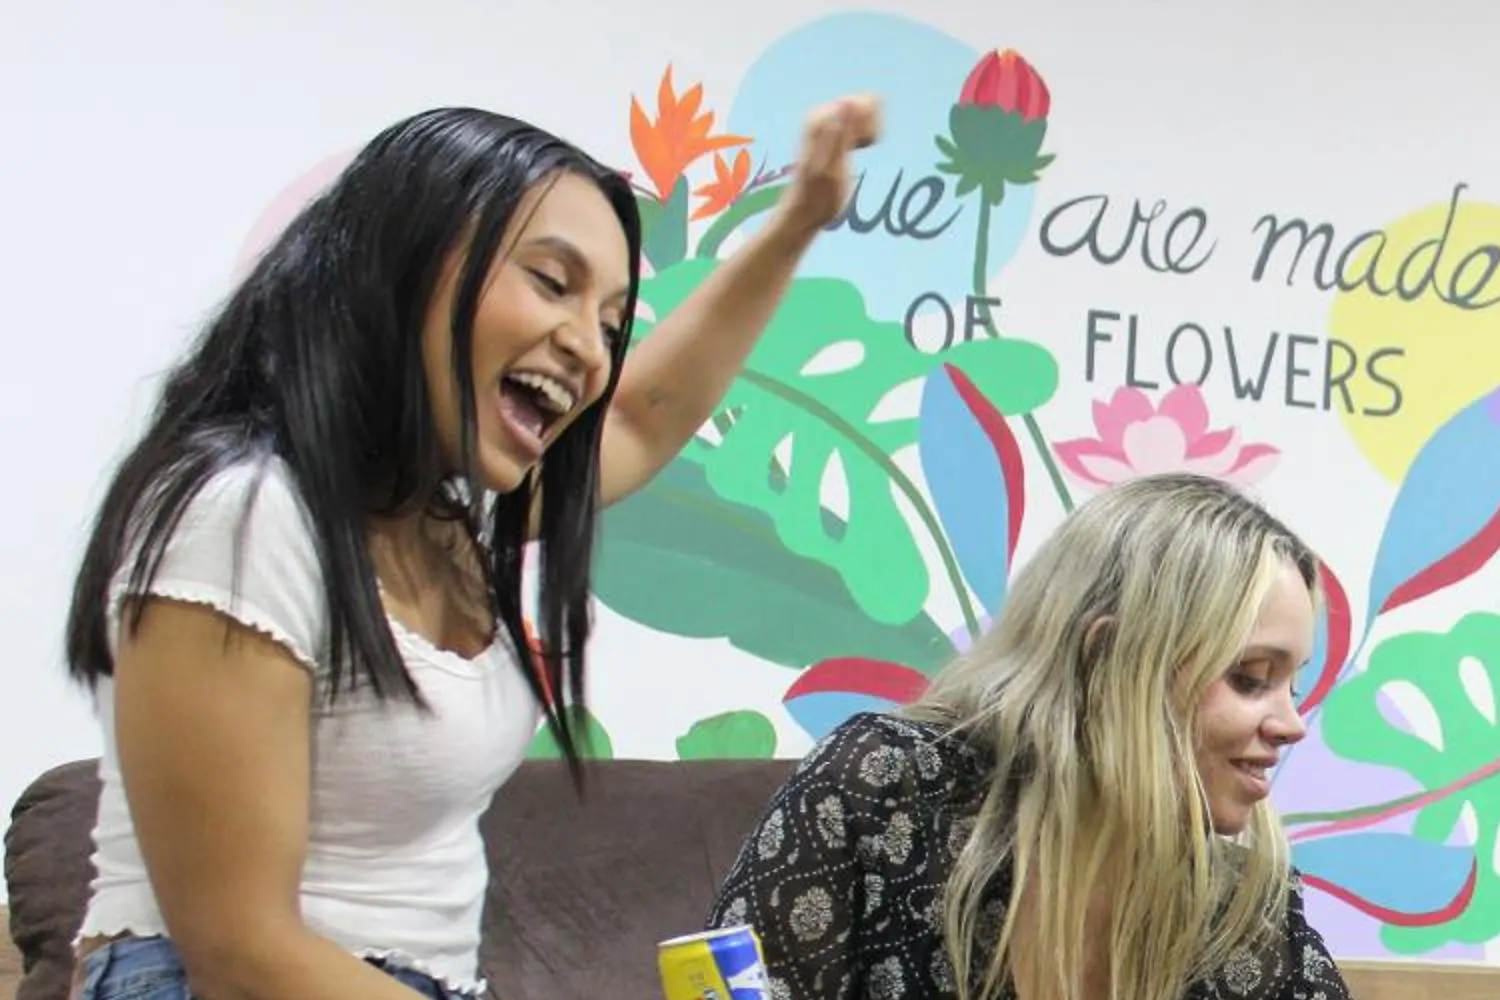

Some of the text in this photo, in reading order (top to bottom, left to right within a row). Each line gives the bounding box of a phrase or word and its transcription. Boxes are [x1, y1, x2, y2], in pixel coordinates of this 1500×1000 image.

[1038, 194, 1218, 274] are
[903, 290, 1406, 418] OF FLOWERS
